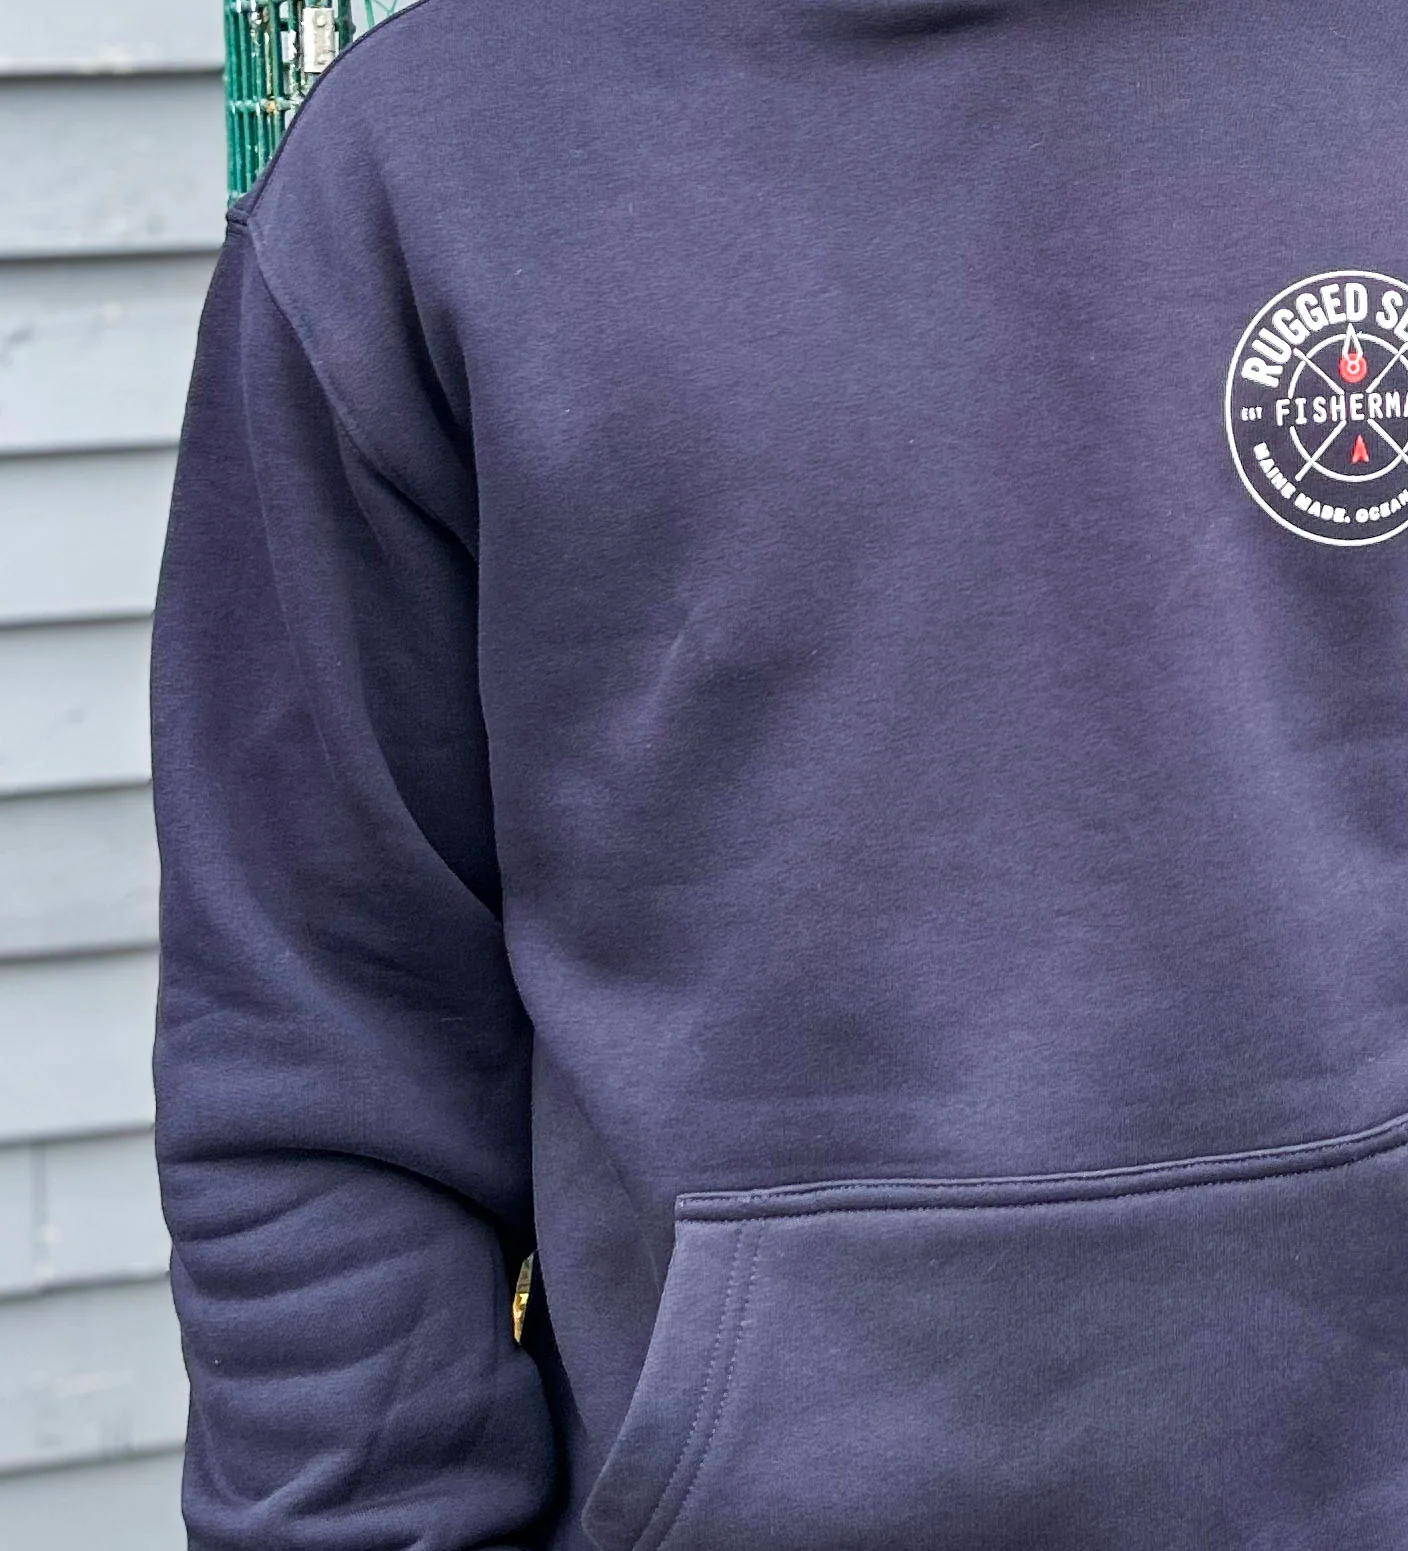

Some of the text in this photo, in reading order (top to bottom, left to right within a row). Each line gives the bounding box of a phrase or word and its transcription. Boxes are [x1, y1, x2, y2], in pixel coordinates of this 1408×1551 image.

[1241, 282, 1368, 389] RUGGED
[1241, 406, 1262, 422] EST
[1253, 442, 1296, 499] MAINE
[1294, 492, 1351, 524] MADE.
